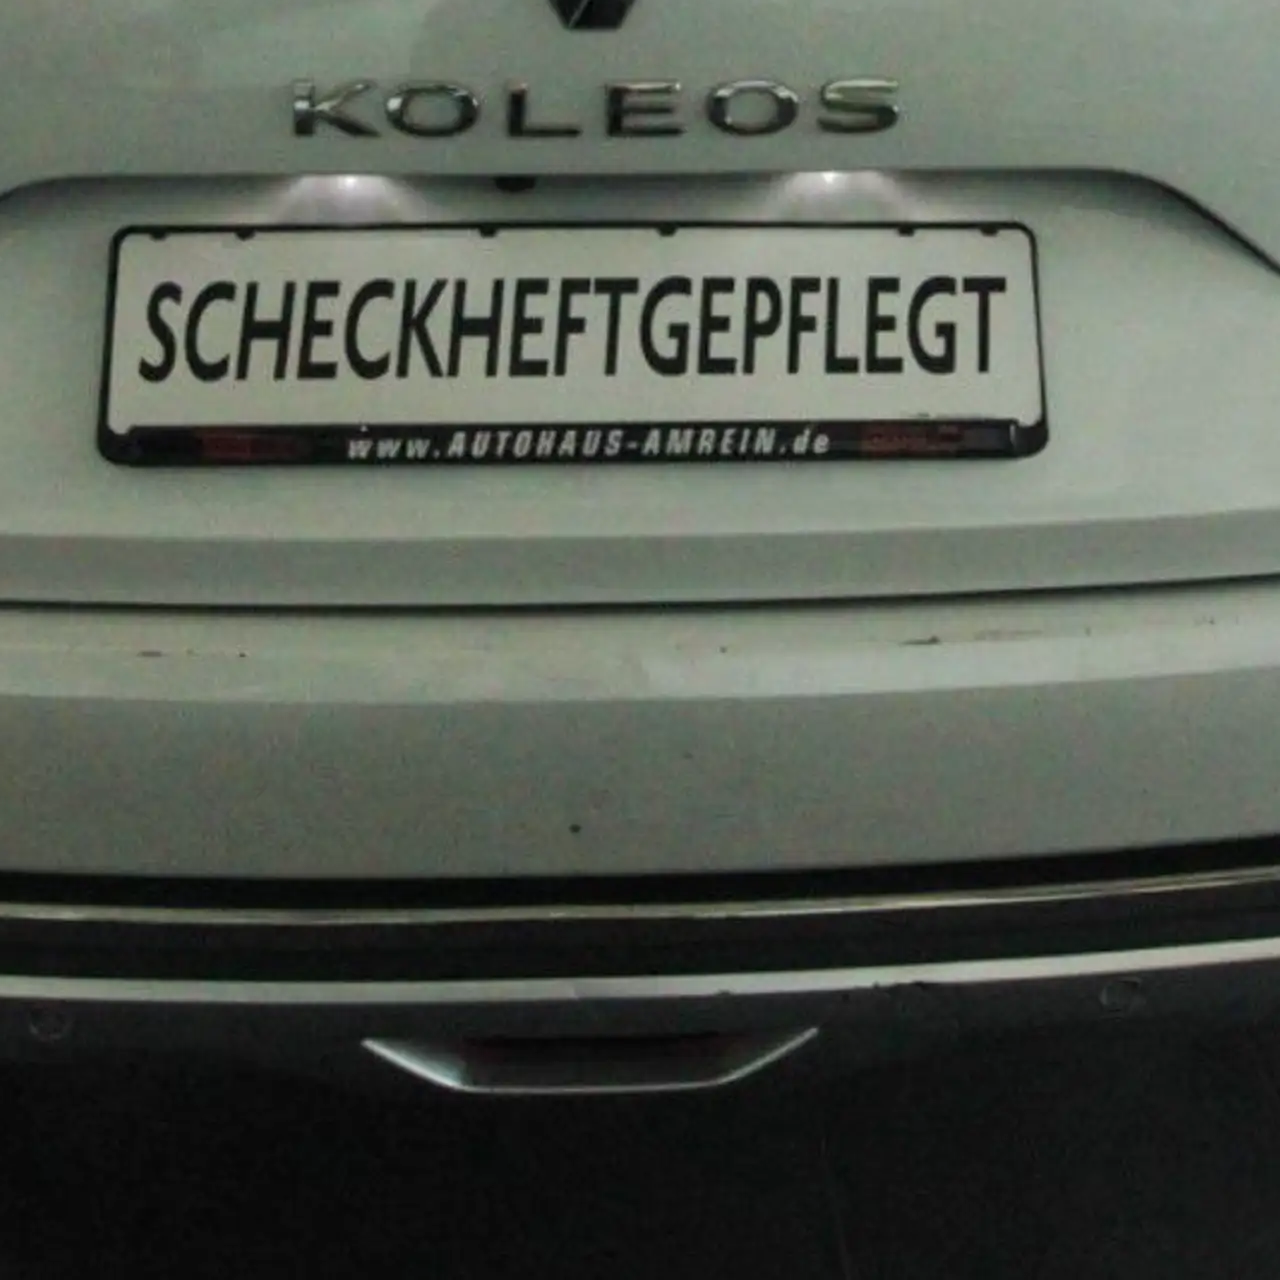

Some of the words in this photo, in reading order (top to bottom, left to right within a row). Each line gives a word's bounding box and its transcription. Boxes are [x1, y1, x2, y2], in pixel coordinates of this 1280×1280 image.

[292, 78, 900, 138] KOLEOS
[136, 274, 1008, 384] SCHECKHEFTGEPFLEGT
[347, 424, 831, 461] www.AUTOHAUS-AMREIN.de
